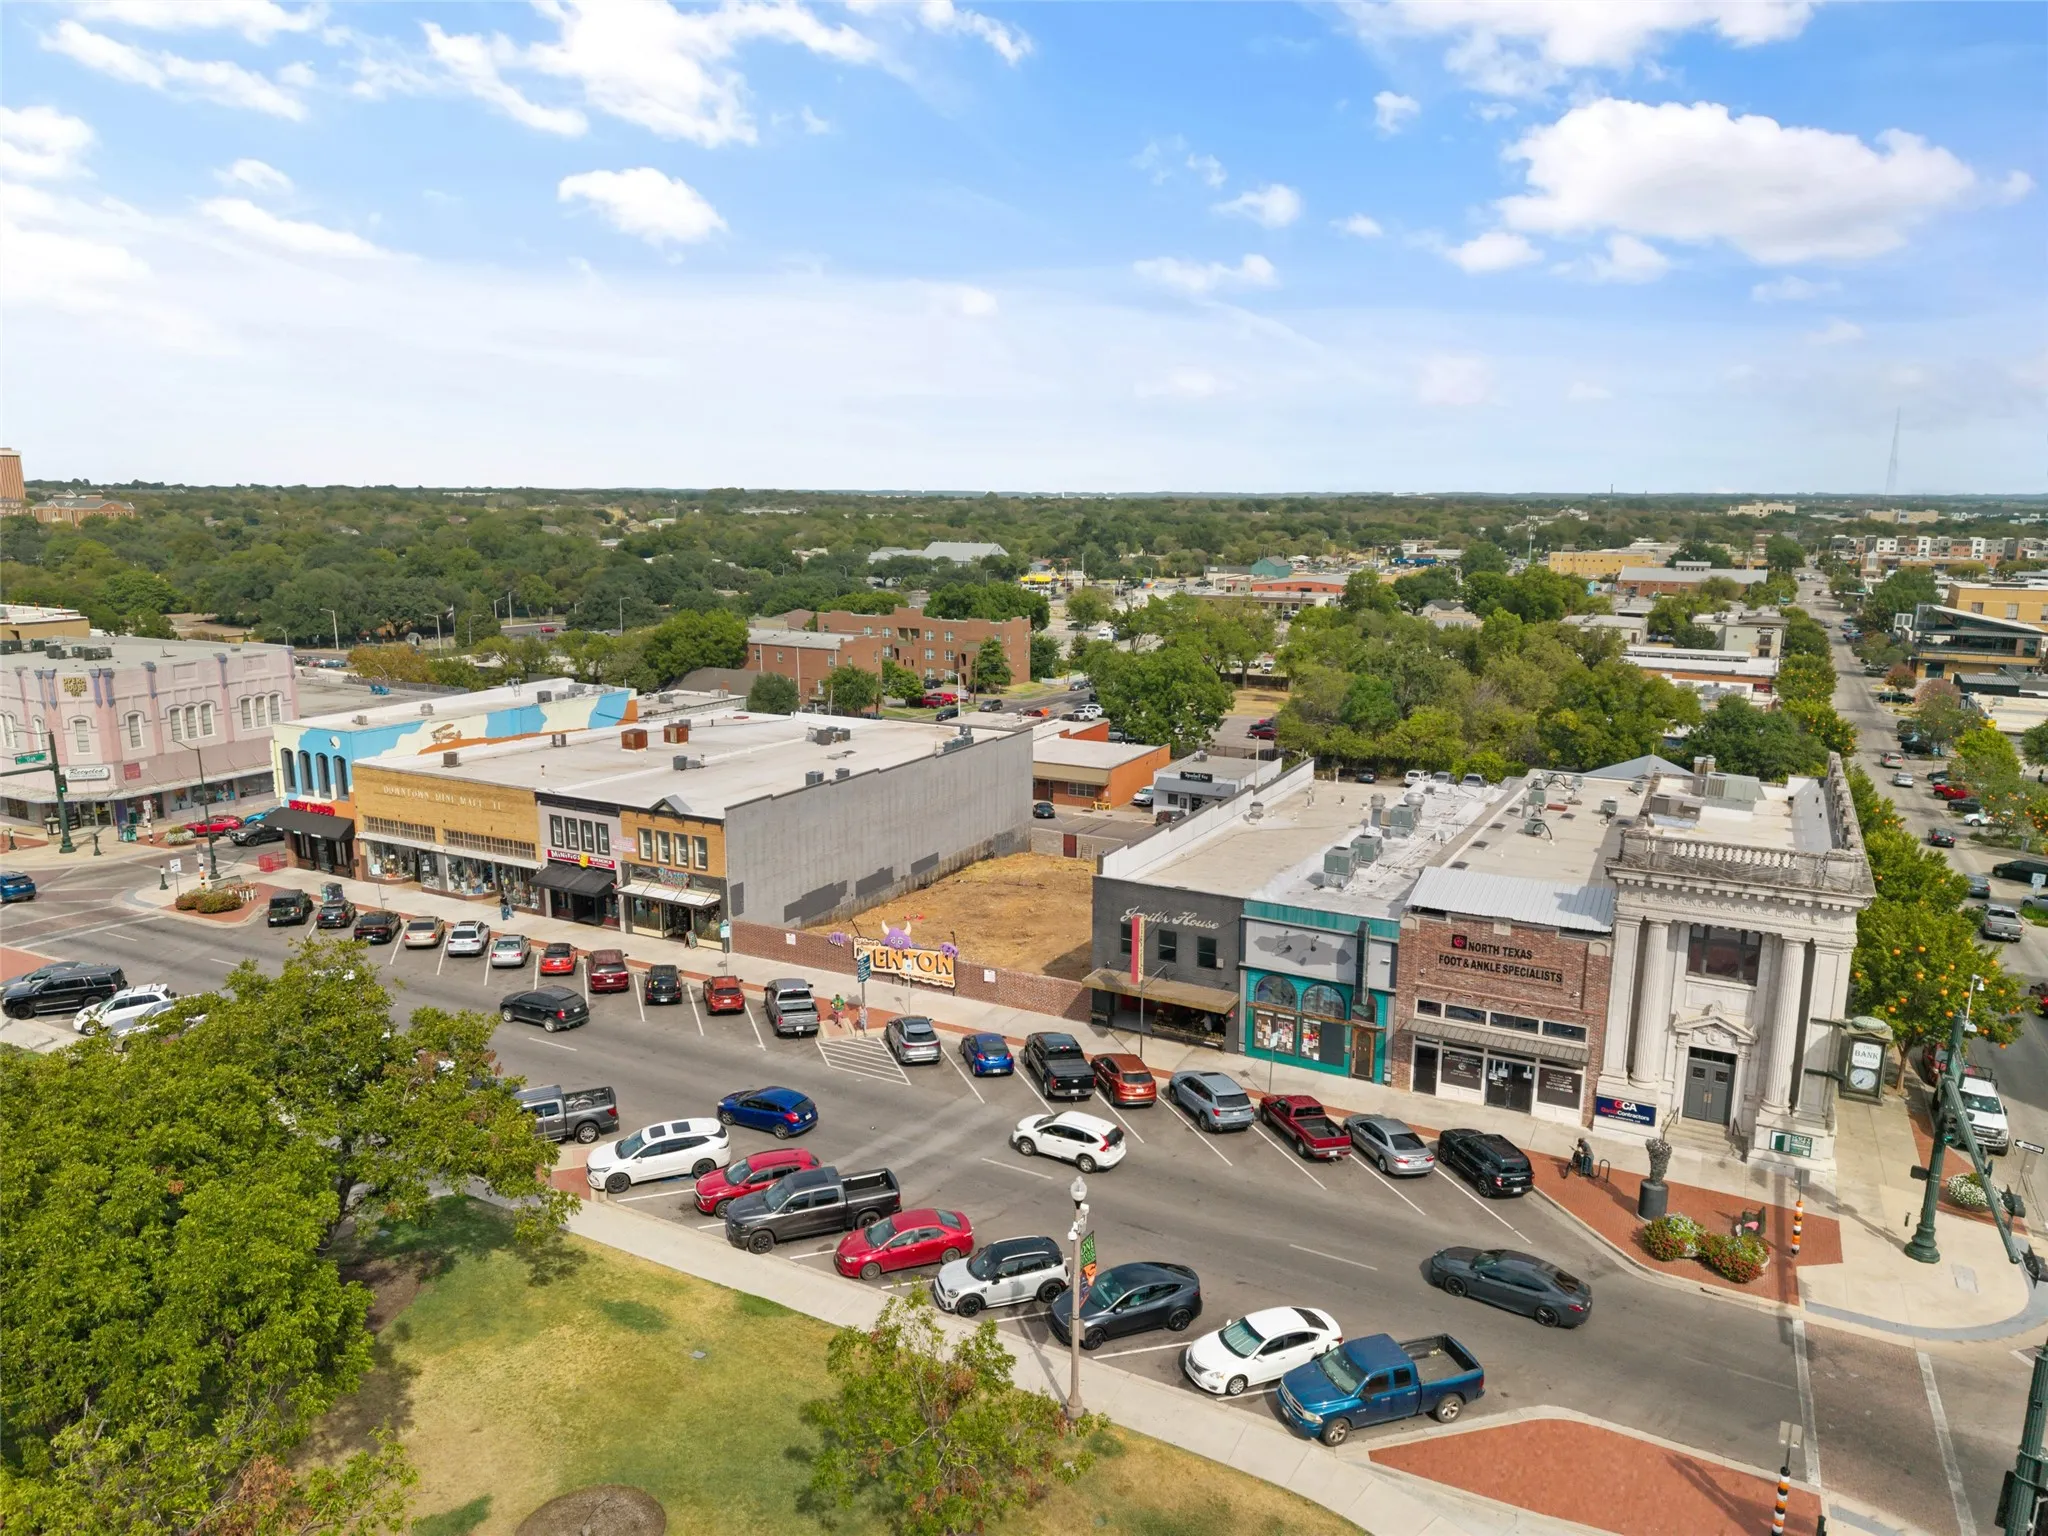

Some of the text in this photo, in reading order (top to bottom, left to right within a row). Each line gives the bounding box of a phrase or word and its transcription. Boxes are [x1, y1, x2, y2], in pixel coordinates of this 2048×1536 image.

[69, 766, 104, 775] Recycled
[383, 785, 429, 800] DOWNTOWN
[435, 792, 454, 804] MINI
[1172, 911, 1220, 930] House
[1468, 941, 1533, 960] NORTH TEXAS
[1439, 954, 1563, 983] FOOT & ANKLE SPECIALISTS
[1855, 1050, 1879, 1060] BANK
[1614, 1100, 1638, 1112] GCA
